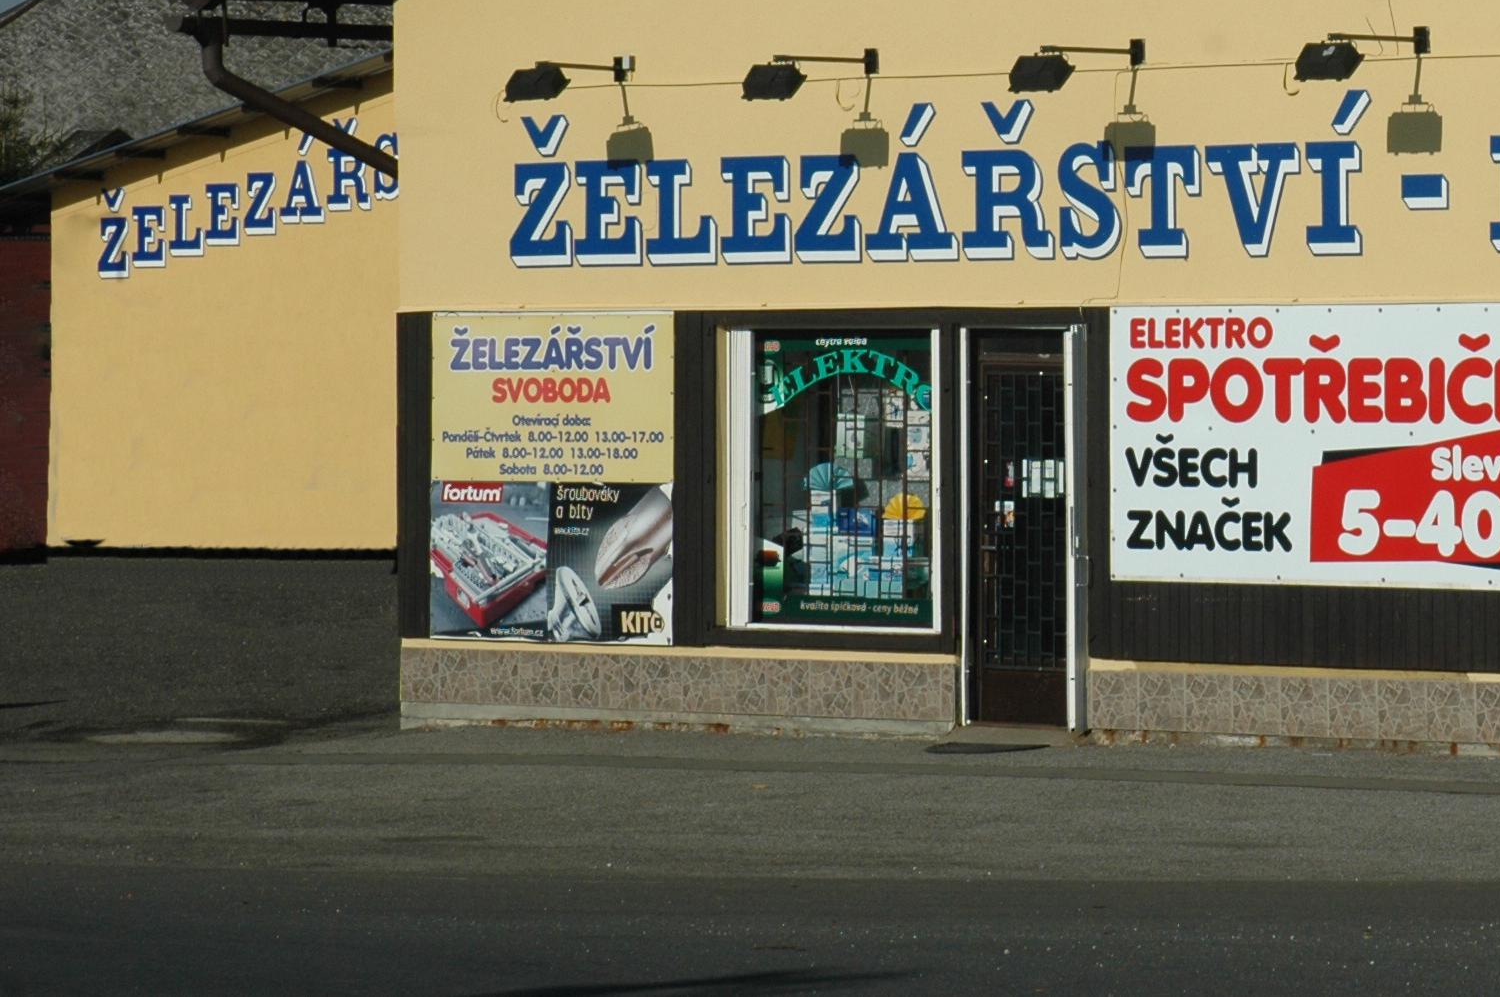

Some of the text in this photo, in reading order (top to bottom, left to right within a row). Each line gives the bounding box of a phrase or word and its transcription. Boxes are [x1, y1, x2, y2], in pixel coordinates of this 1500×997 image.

[510, 89, 1372, 267] ŽELEZÁŘSTVÍ
[1402, 173, 1449, 210] -
[1129, 316, 1274, 349] ELEKTRO
[450, 324, 656, 371] ŽELEZÁŘSTVÍ
[491, 377, 611, 404] SVOBODA
[512, 414, 592, 427] Otevírací doba:
[442, 427, 664, 443] Pondělí-Čtvrtek 8.00-12.00 13.00-17.00
[466, 445, 638, 460] Pátek 8.00-12.00 13.00-18.00
[1125, 433, 1259, 488] VŠECH
[499, 463, 604, 476] Sobota 8.00-12.00
[443, 483, 502, 502] fortum
[556, 484, 620, 503] šroubováky
[555, 505, 594, 521] a bity
[1126, 496, 1293, 553] ZNAČEK
[620, 610, 666, 634] KITO
